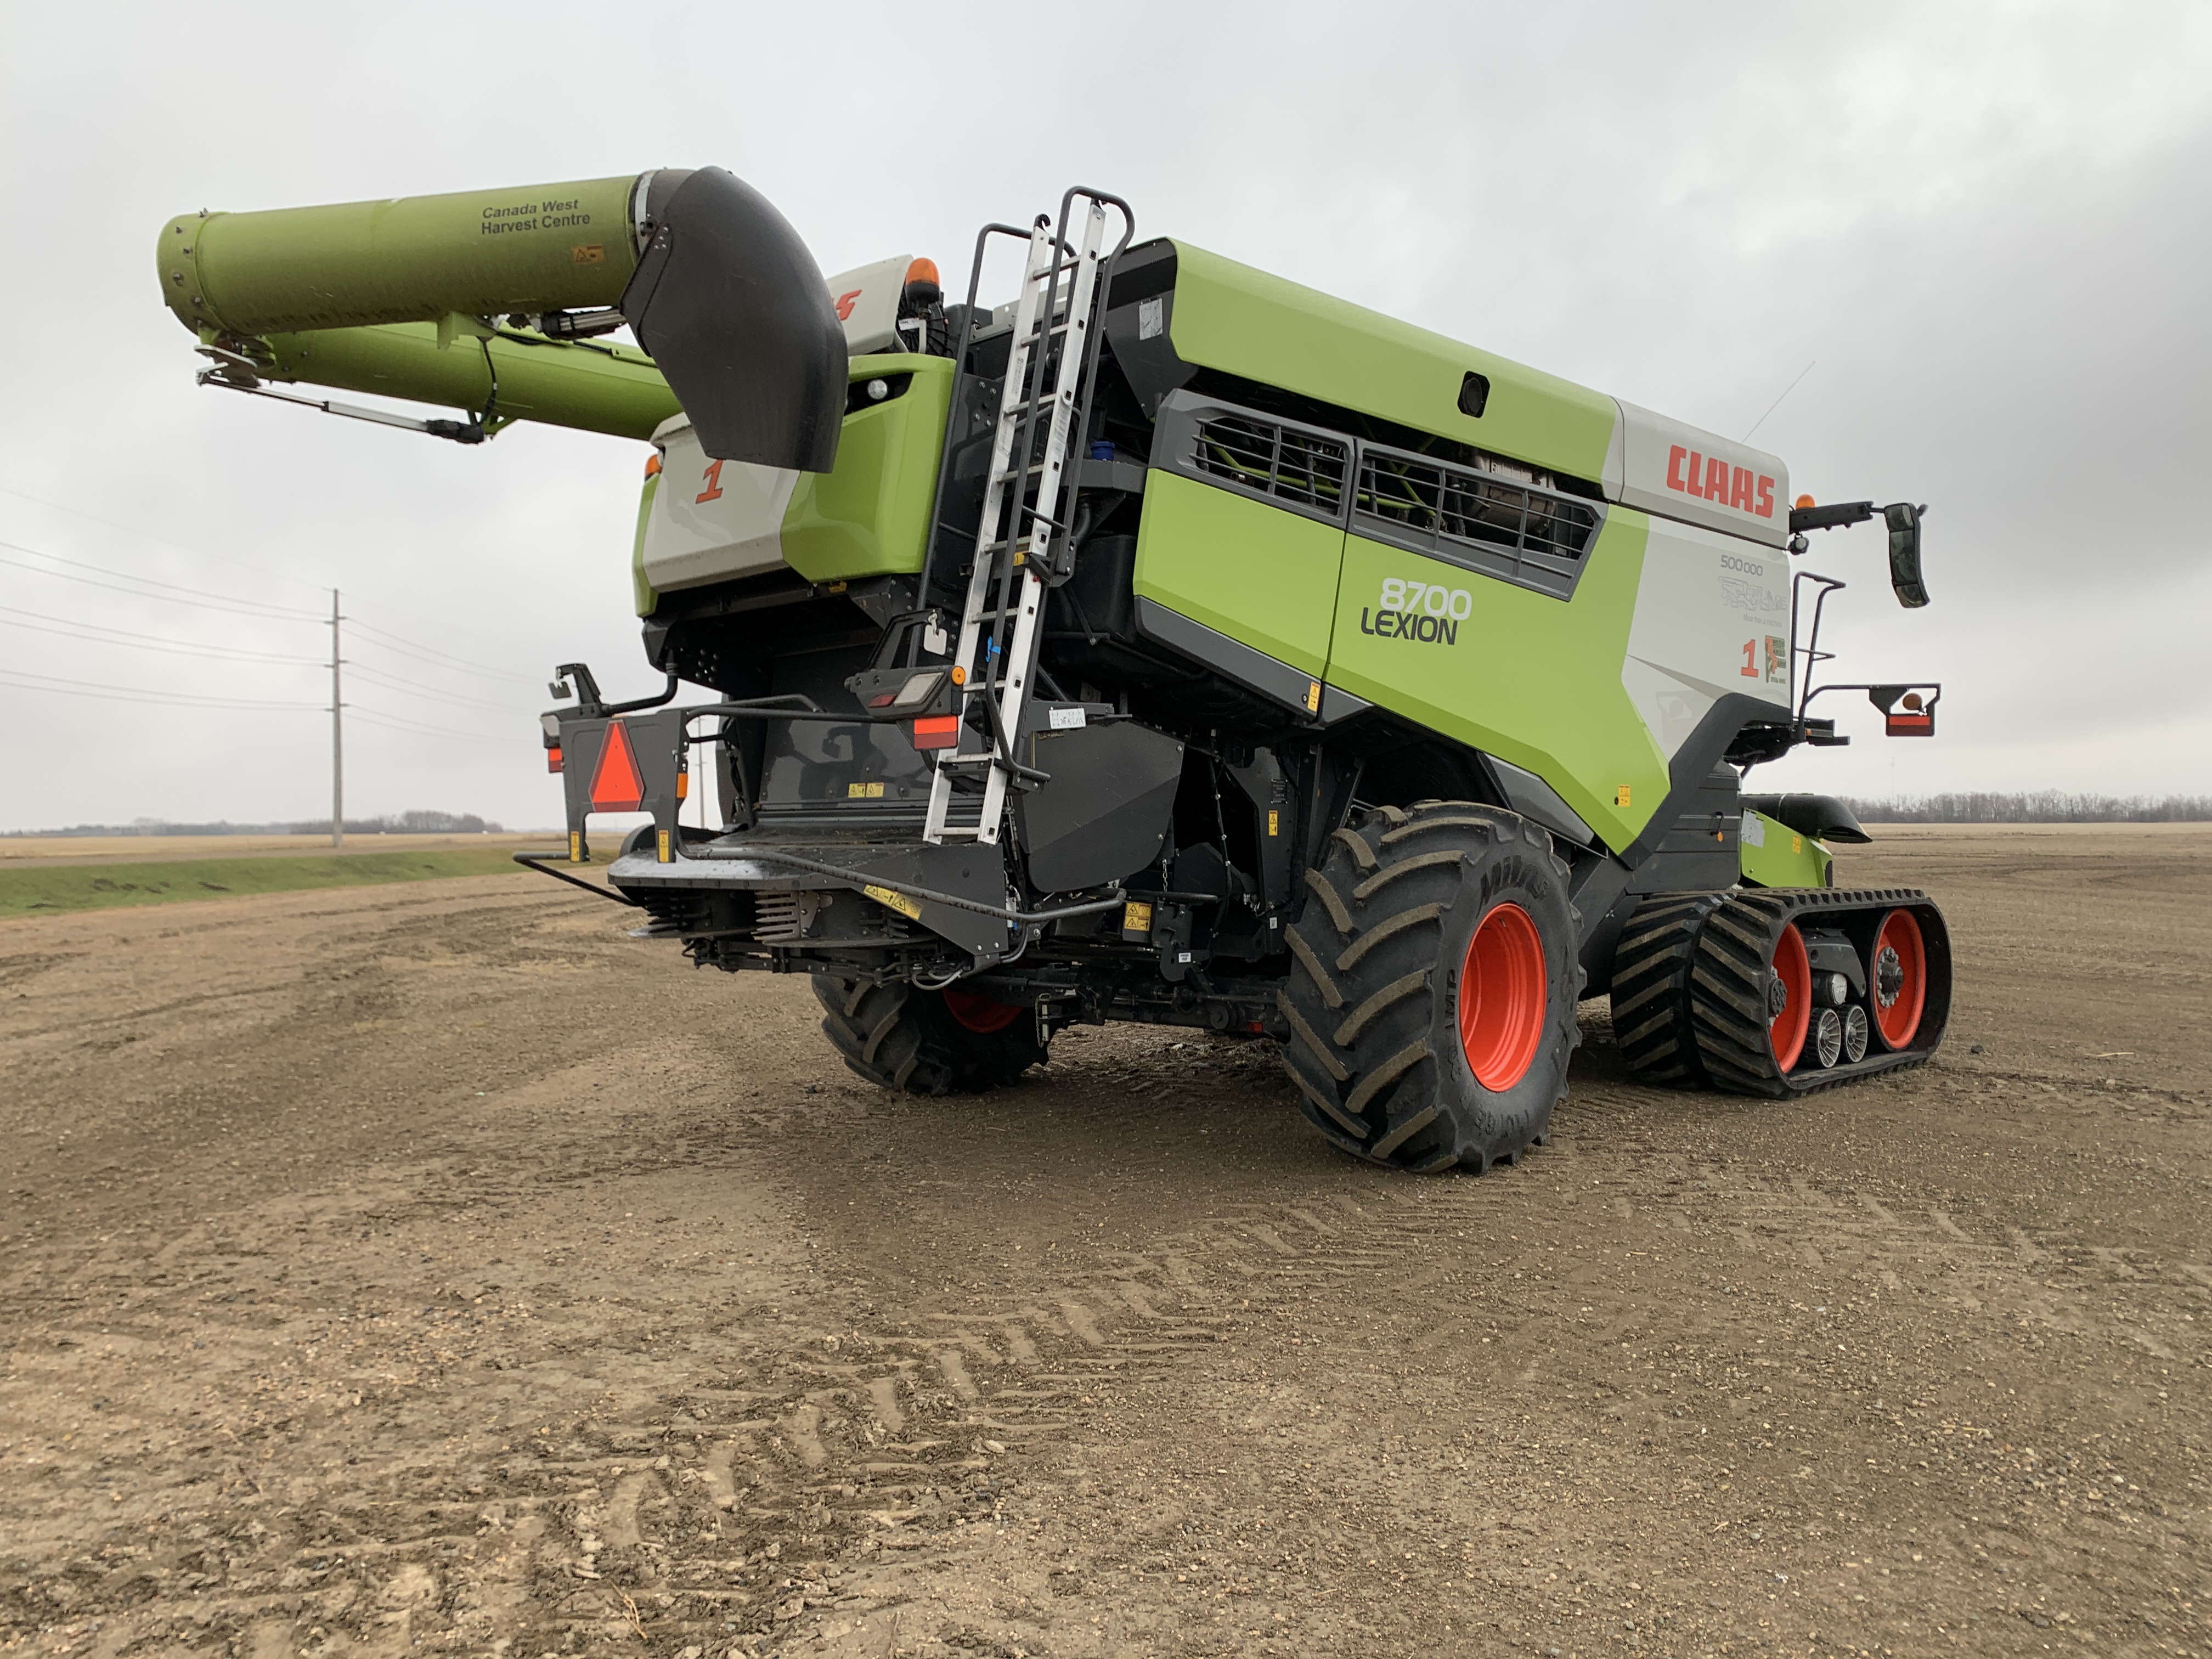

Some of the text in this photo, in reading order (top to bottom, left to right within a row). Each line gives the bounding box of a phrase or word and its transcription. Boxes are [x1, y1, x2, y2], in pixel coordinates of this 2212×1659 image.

[481, 213, 591, 234] Harvest Centre
[483, 199, 579, 218] Canada West
[1666, 444, 1775, 518] CLAAS
[1380, 578, 1472, 620] 8700
[1361, 607, 1458, 645] LEXION
[1741, 639, 1758, 678] 1
